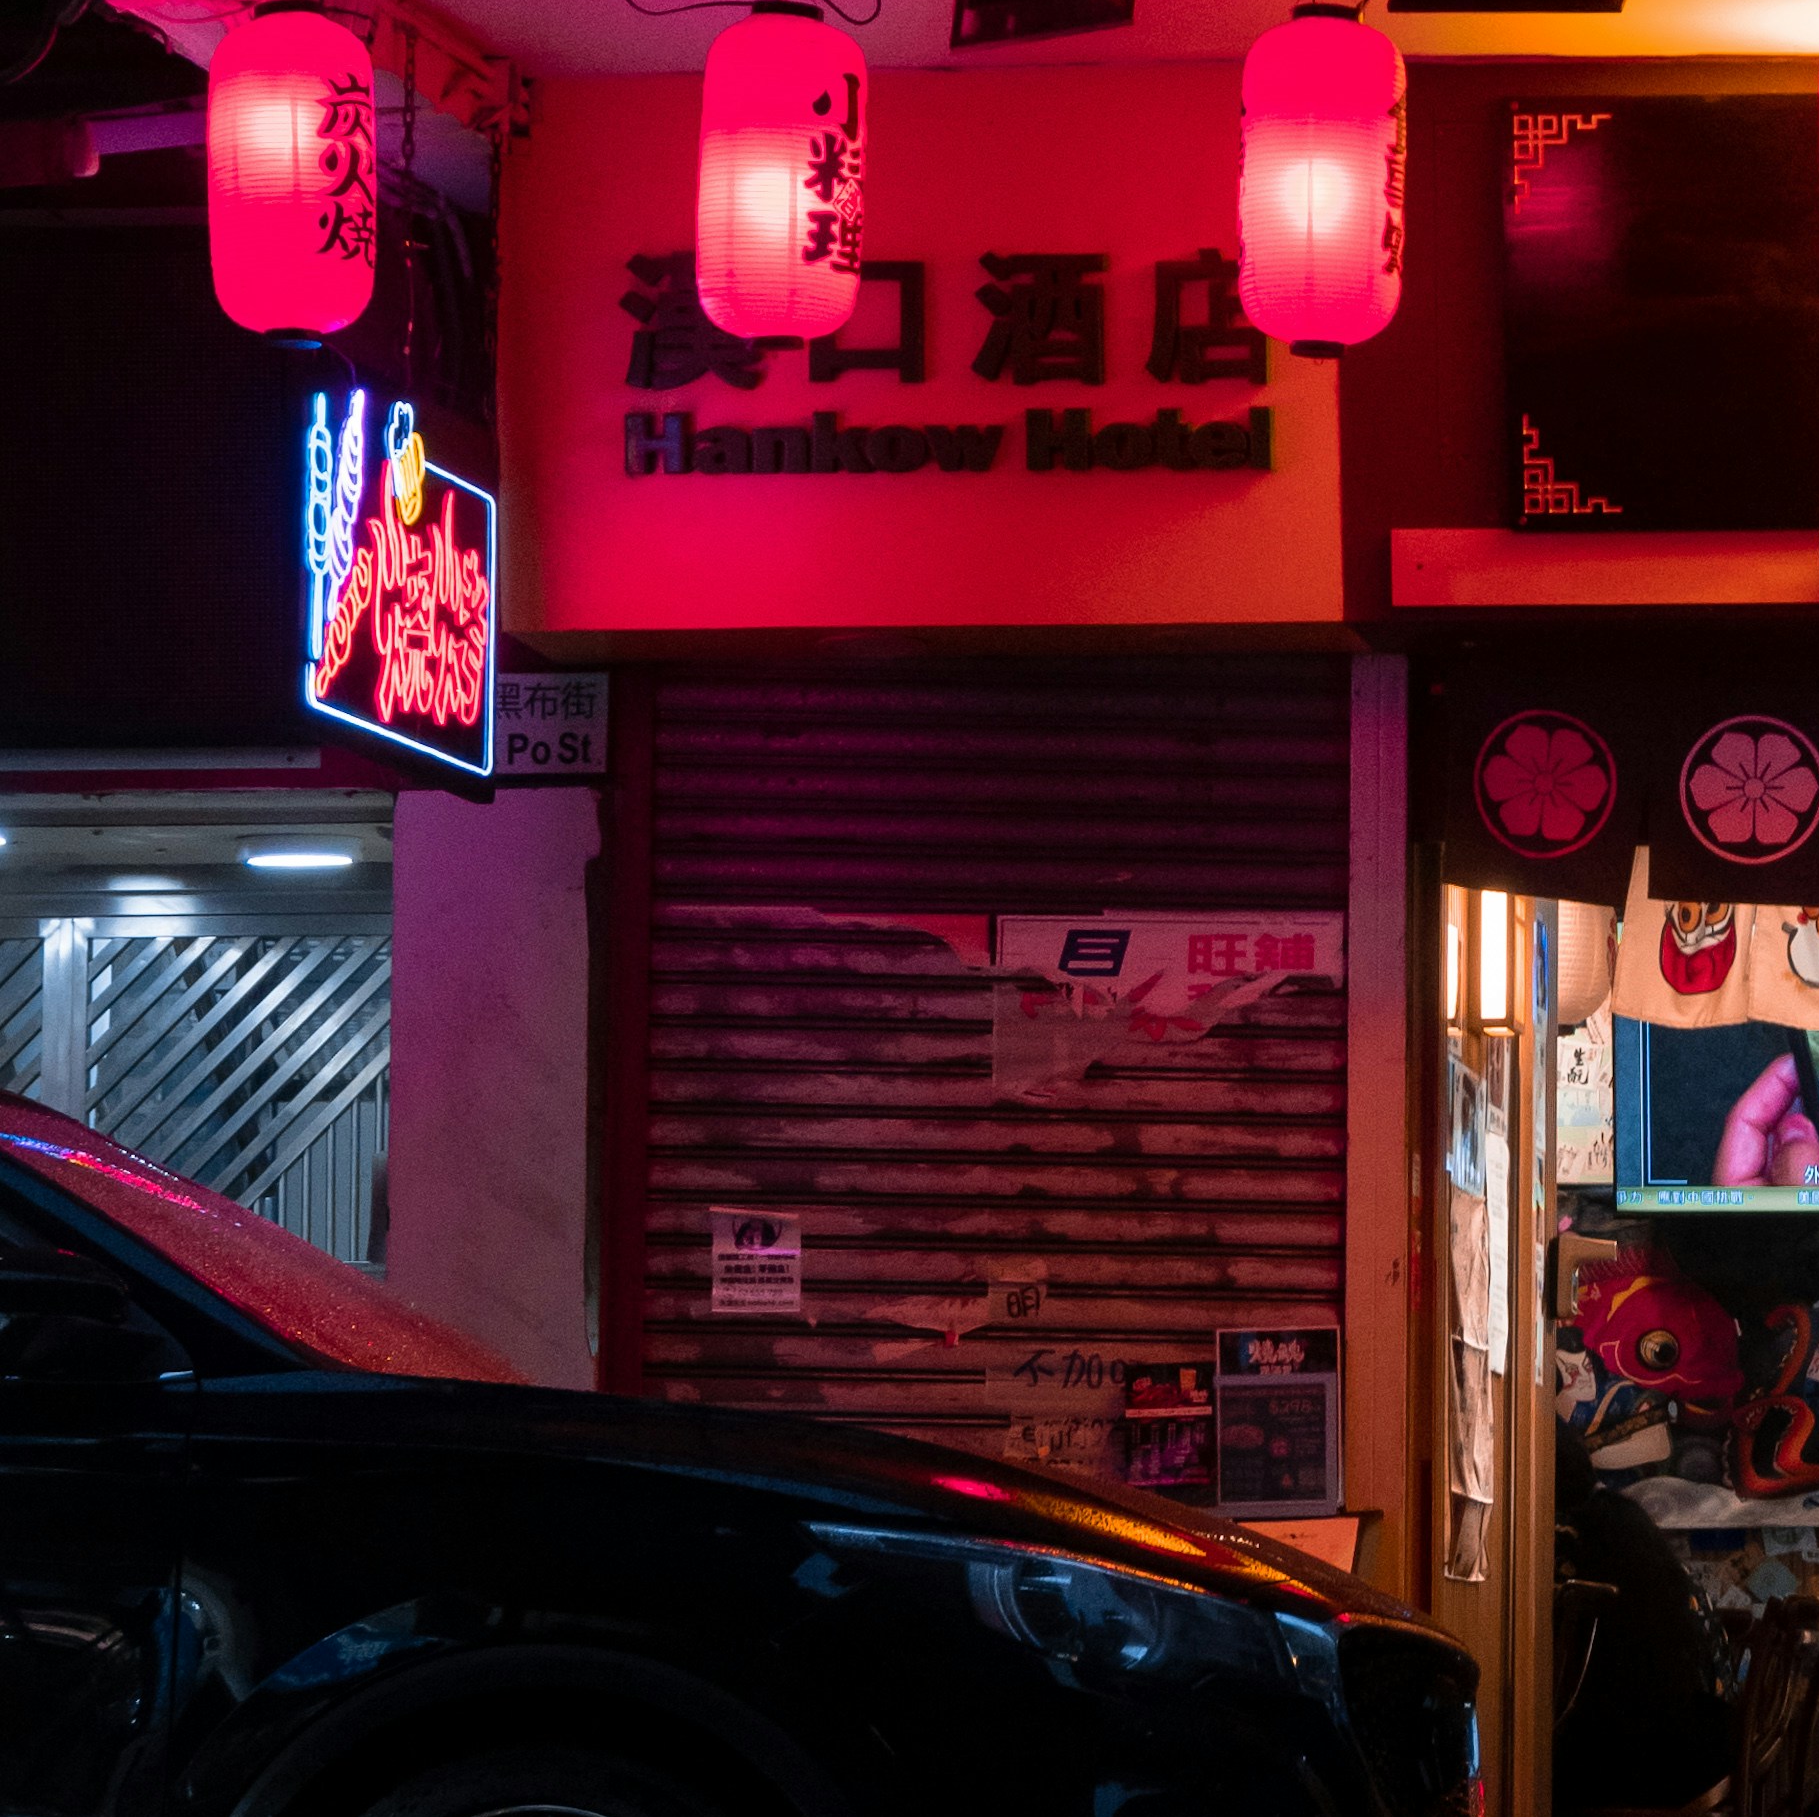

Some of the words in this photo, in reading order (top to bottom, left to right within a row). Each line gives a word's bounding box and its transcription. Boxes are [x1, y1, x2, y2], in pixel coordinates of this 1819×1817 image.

[625, 409, 1003, 475] Hankow
[1025, 407, 1271, 473] Hotel
[507, 732, 551, 765] Po
[557, 731, 592, 765] St
[1188, 933, 1315, 977] 旺鋪
